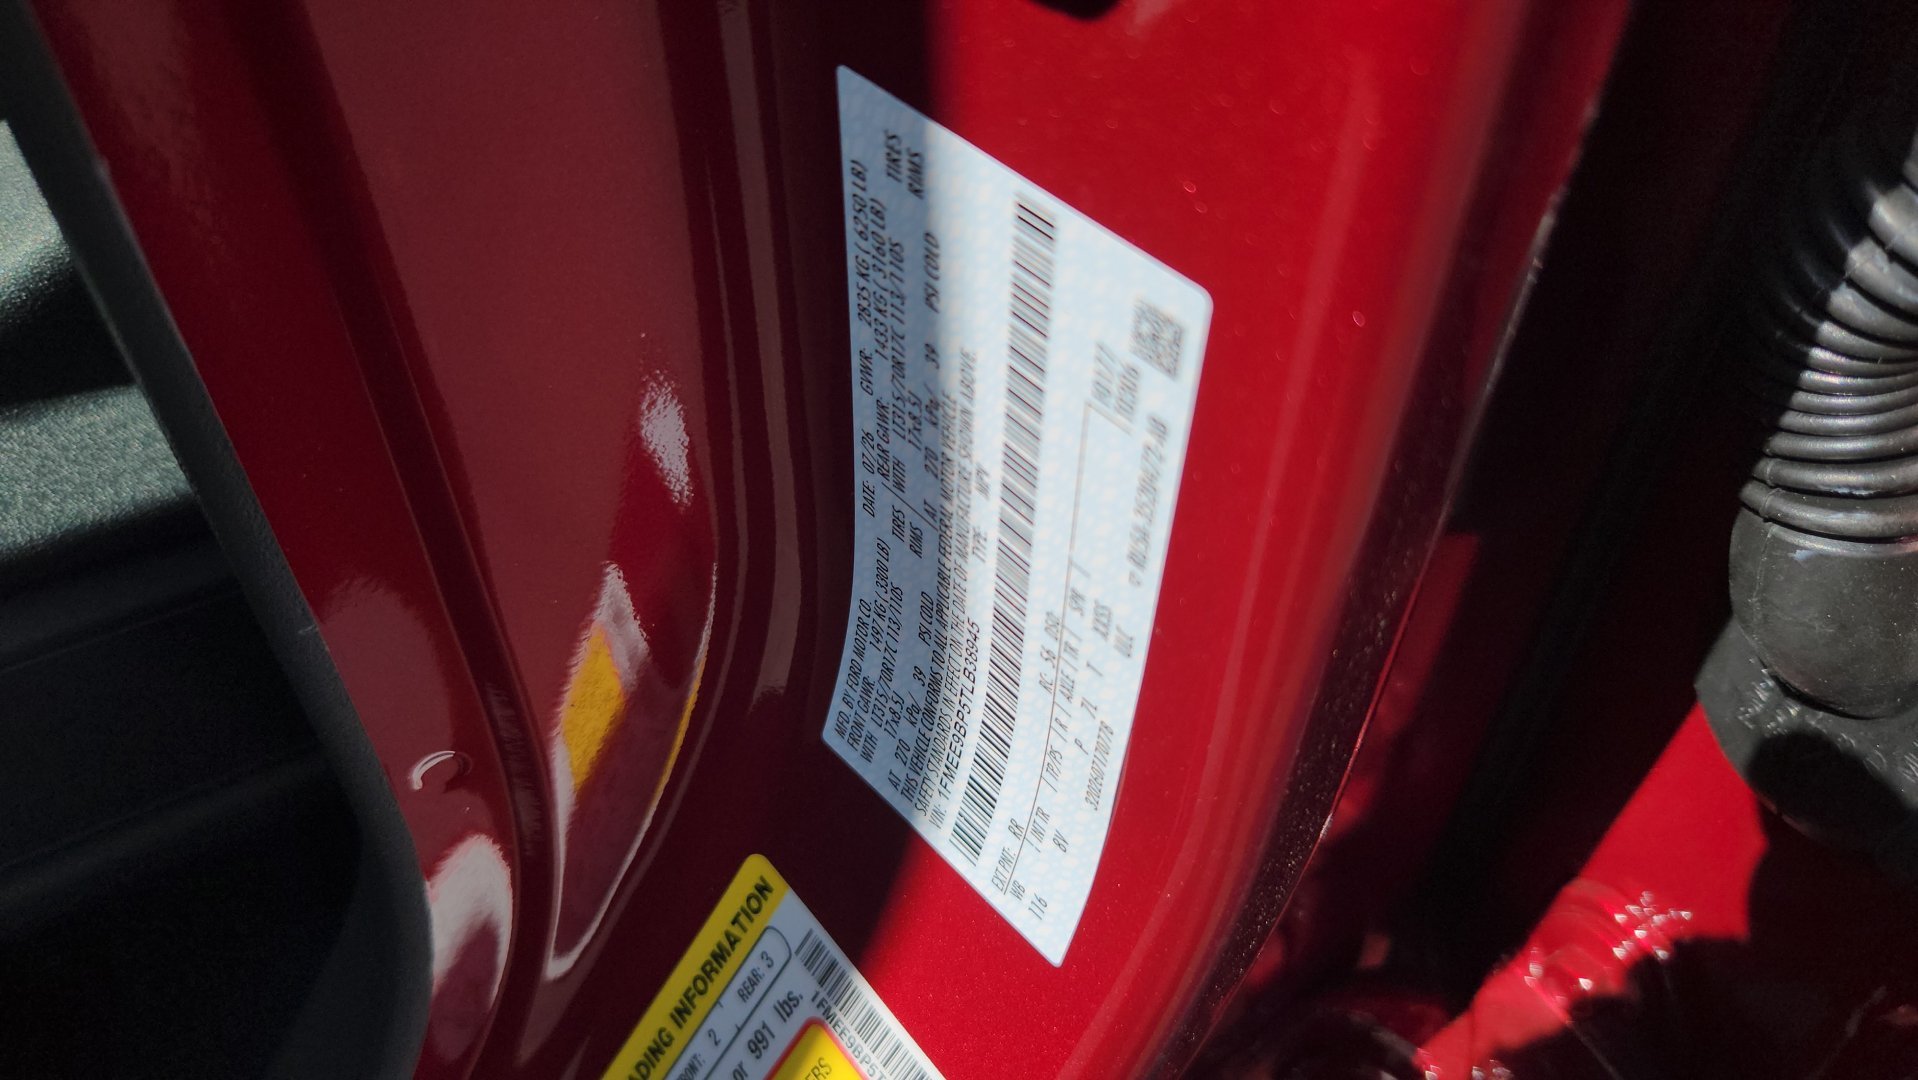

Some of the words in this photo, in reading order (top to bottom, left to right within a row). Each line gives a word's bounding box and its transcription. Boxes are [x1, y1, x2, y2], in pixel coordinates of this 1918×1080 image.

[884, 129, 901, 183] TIRES
[907, 148, 924, 200] RIMS
[850, 159, 867, 192] LB)
[869, 197, 886, 231] LB)
[855, 255, 870, 283] KG
[924, 231, 940, 282] COLD
[889, 237, 904, 325] 113/110S
[925, 282, 939, 314] PSI
[856, 282, 871, 328] 2835
[872, 290, 887, 318] KG
[873, 317, 888, 361] 1433
[924, 343, 940, 370] 39
[859, 349, 873, 396] GVWR:
[890, 325, 906, 440] LT315/70R17C
[960, 348, 976, 405] ABOVE.
[875, 398, 890, 445] GAWR:
[907, 390, 923, 452] 17x8.5J
[940, 389, 957, 452] VEHICLE
[957, 406, 973, 464] SHOWN
[861, 428, 875, 475] 07/26
[876, 442, 890, 482] REAR
[924, 446, 939, 480] 270
[892, 455, 906, 494] WITH
[939, 451, 954, 502] MOTOR
[975, 465, 990, 498] MPV
[862, 480, 875, 518] DATE:
[923, 499, 937, 522] AT
[955, 462, 972, 563] MANUFACTURE
[891, 504, 905, 543] TIRES
[909, 521, 923, 559] RIMS
[938, 504, 953, 562] FEDERAL
[876, 537, 891, 562] LB)
[971, 527, 987, 563] TYPE:
[875, 558, 888, 595] 3300
[953, 559, 968, 582] OF
[858, 598, 871, 619] CO.
[873, 599, 886, 622] KG
[886, 581, 904, 644] 113/110S
[919, 591, 934, 626] COLD
[935, 558, 951, 632] APPLICABLE
[952, 578, 966, 615] DATE
[852, 616, 869, 662] MOTOR
[869, 617, 884, 653] 1497
[918, 622, 932, 647] PSI
[933, 629, 948, 654] ALL
[950, 609, 965, 638] THE
[931, 649, 945, 671] TO
[949, 638, 963, 658] ON
[1062, 639, 1079, 659] TR
[846, 658, 862, 693] FORD
[870, 640, 897, 728] LT315/70R17C
[912, 665, 926, 687] 39
[944, 652, 961, 697] EFFECT
[1058, 669, 1075, 703] AXLE
[841, 688, 855, 710] BY
[857, 675, 875, 714] GAWR:
[903, 691, 921, 728] kPa/
[920, 666, 943, 732] CONFORMS
[937, 617, 980, 800] 1FMEE9BP5TLB38945
[941, 693, 955, 713] IN
[834, 710, 851, 740] MFD.
[846, 709, 866, 752] FRONT
[883, 690, 904, 739] 17x8.5J
[1054, 717, 1068, 731] R
[860, 730, 878, 763] WITH
[894, 738, 910, 767] 270
[908, 727, 931, 777] VEHICLE
[926, 707, 953, 778] STANDARDS
[887, 769, 901, 792] AT
[1045, 744, 1063, 781] TP/PS
[900, 772, 918, 803] THIS
[914, 771, 935, 817] SAFETY
[928, 804, 947, 830] VIN:
[1007, 818, 1024, 841] RR
[1028, 893, 1048, 921] 116
[1052, 829, 1069, 853] 8V
[1074, 737, 1089, 755] P
[1030, 818, 1046, 843] INT
[1035, 806, 1049, 824] TR
[998, 846, 1016, 873] PNT:
[991, 866, 1007, 892] EXT
[1009, 880, 1026, 901] WB
[669, 875, 774, 1030] INFORMATION
[707, 1028, 721, 1046] 2
[737, 966, 766, 1003] REAR:
[760, 950, 774, 969] 3
[732, 1061, 749, 1080] or
[747, 1020, 776, 1060] 991
[772, 990, 804, 1024] lbs.
